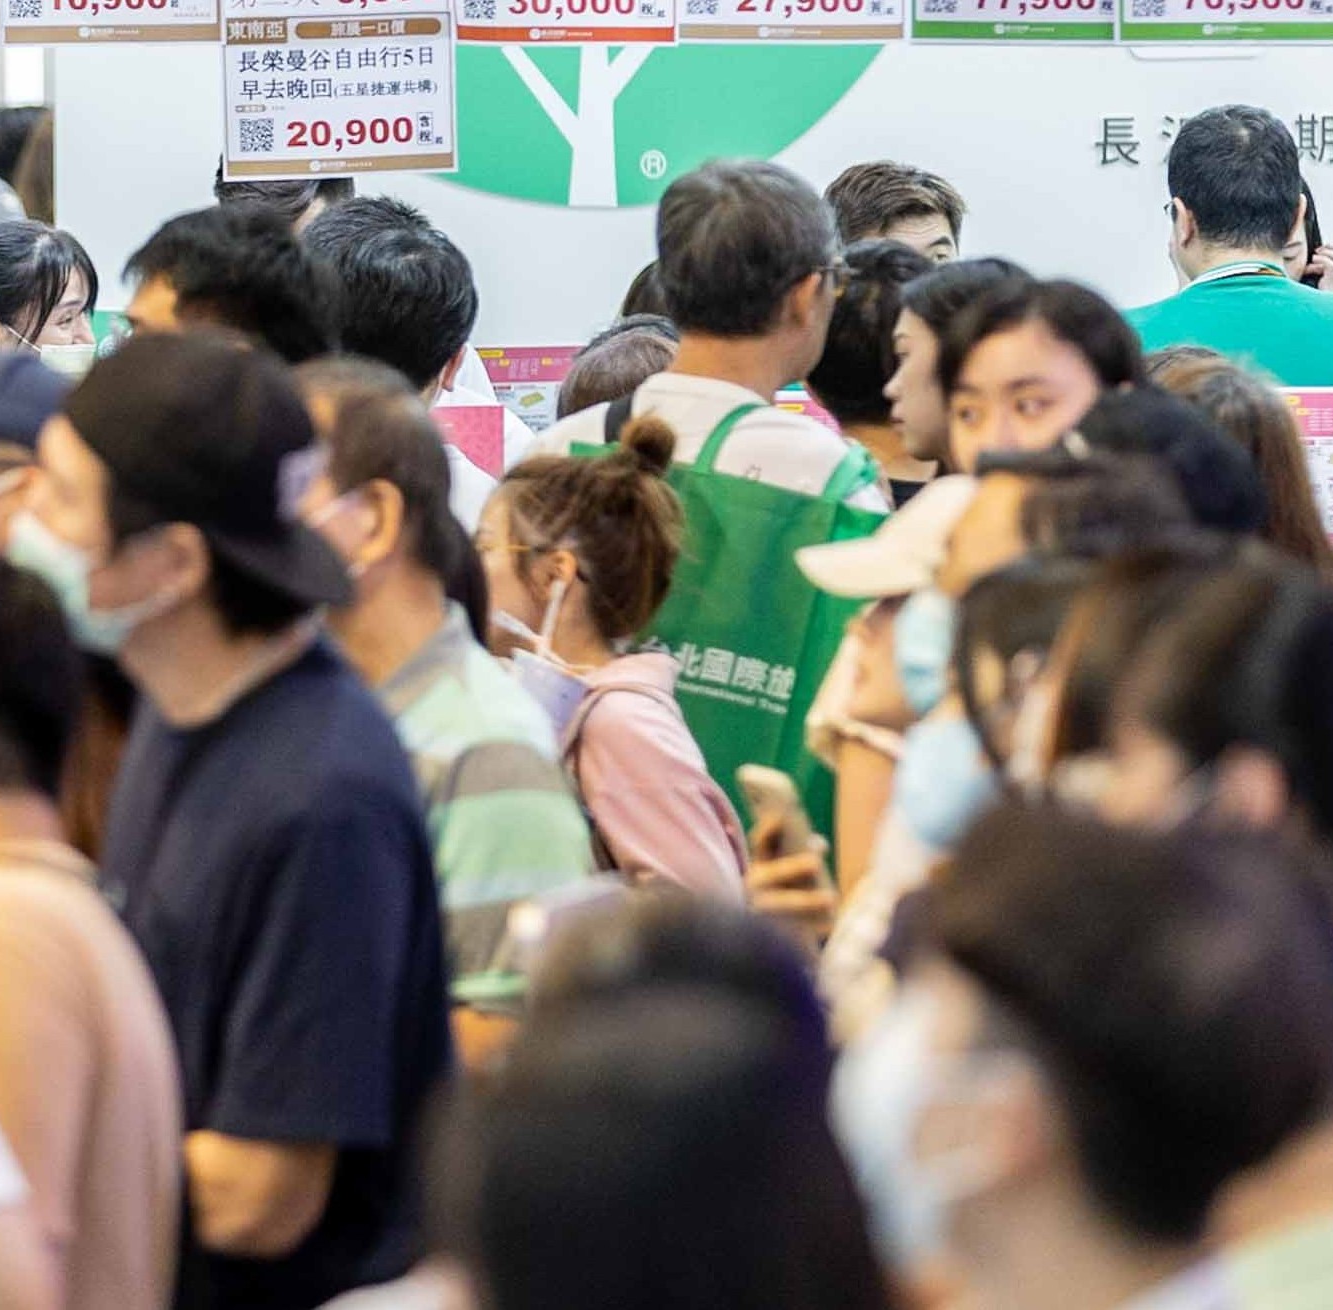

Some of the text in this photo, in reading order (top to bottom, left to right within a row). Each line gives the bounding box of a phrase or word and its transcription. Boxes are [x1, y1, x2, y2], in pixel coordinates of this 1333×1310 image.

[227, 20, 285, 39] 東南亞
[238, 46, 434, 73] 長榮曼谷自由行5日
[286, 116, 414, 152] 20,900
